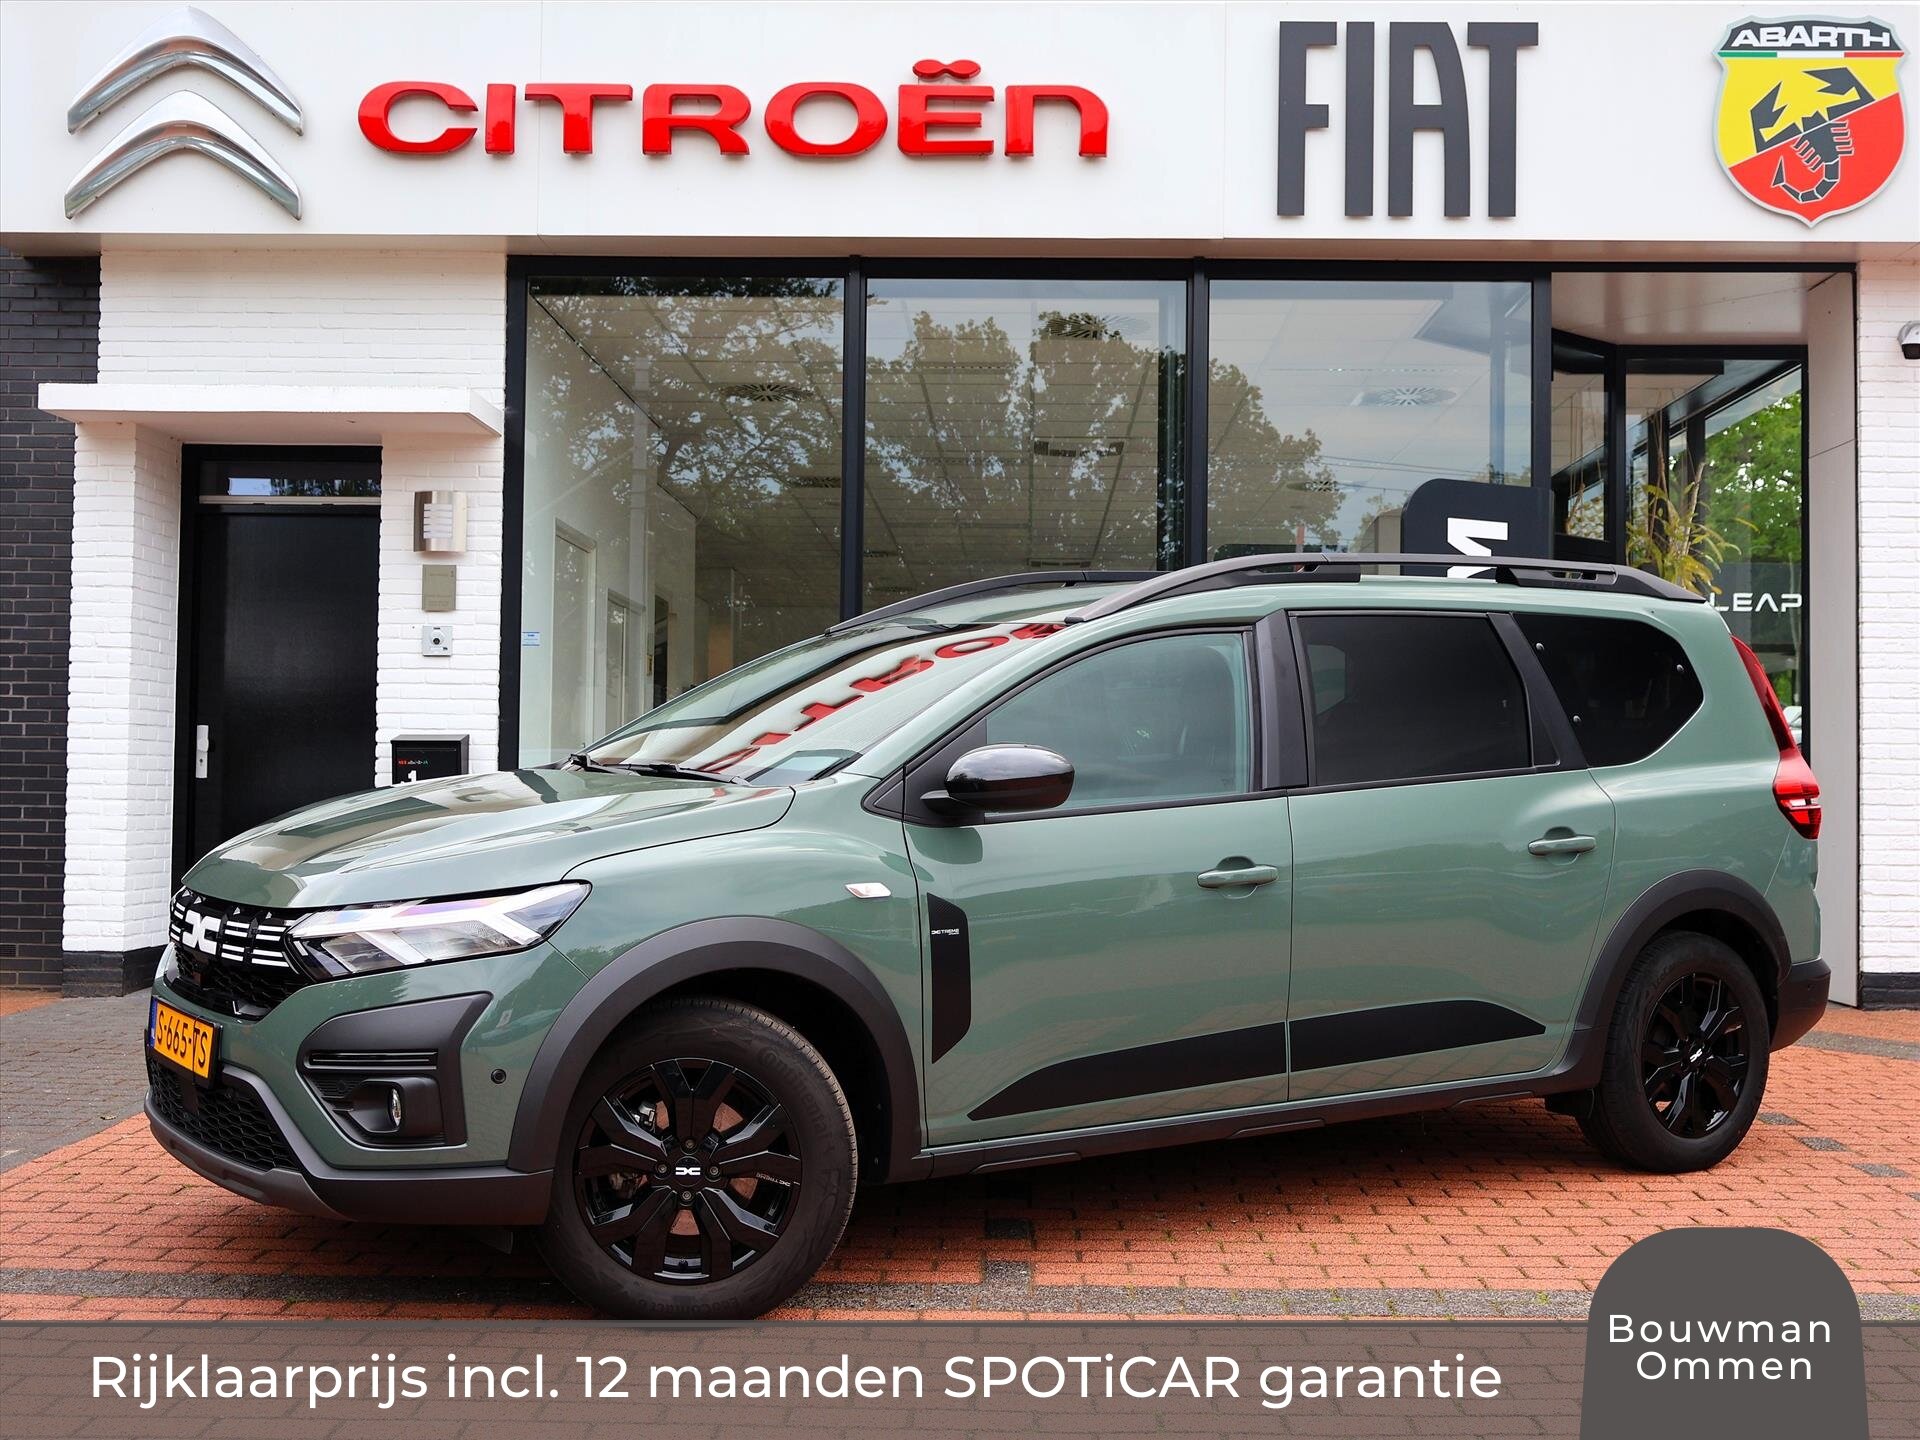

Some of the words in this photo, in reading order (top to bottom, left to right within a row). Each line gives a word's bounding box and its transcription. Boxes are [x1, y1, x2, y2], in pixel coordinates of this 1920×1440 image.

[1731, 25, 1890, 47] ABARTH
[1277, 21, 1538, 218] FIAT
[156, 1009, 209, 1069] S-665-TS
